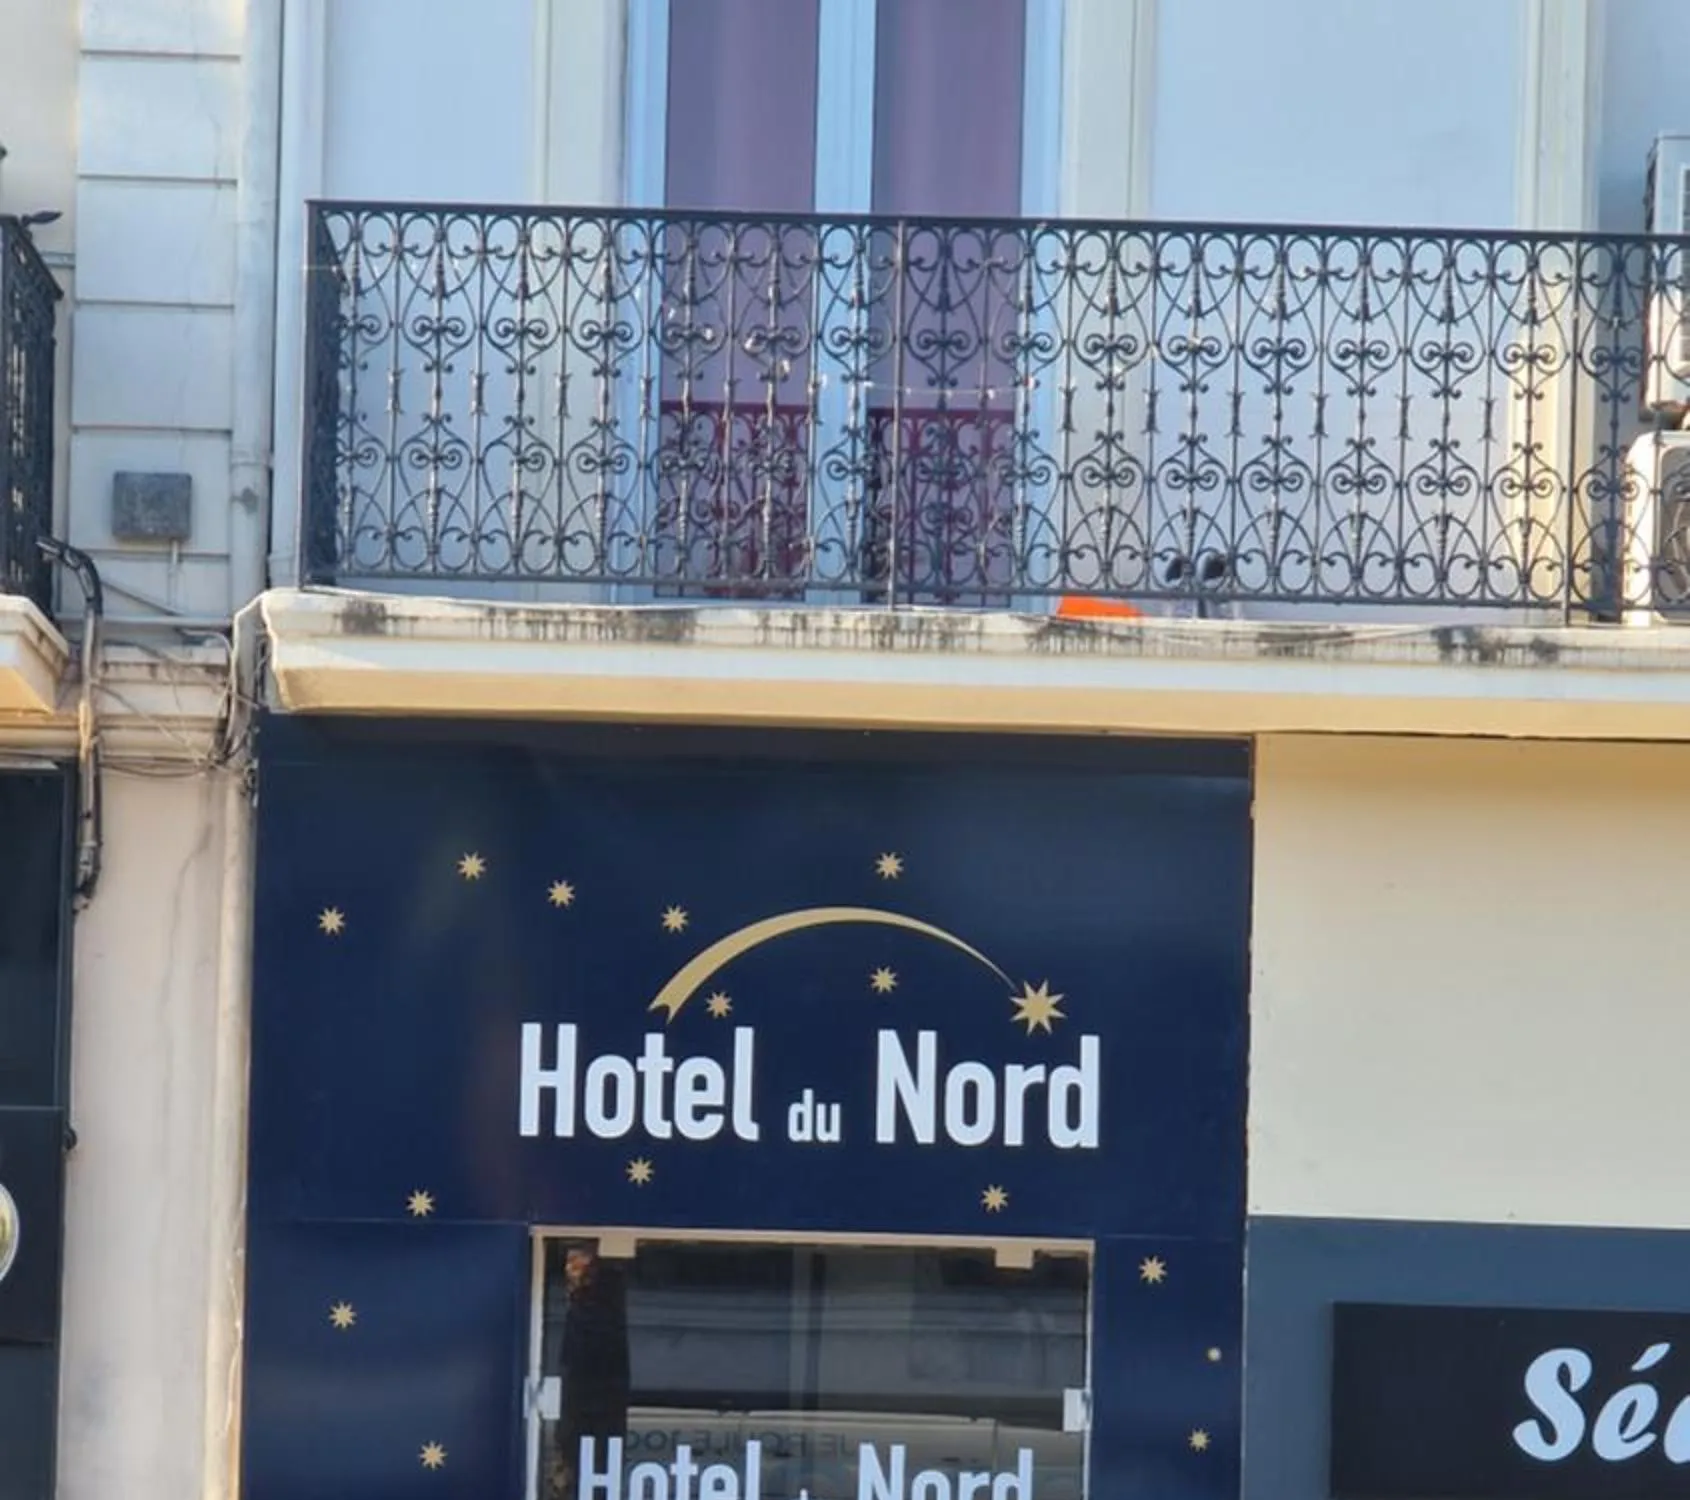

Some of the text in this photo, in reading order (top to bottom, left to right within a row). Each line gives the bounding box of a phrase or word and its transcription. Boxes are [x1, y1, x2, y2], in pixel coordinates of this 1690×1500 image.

[519, 1022, 1101, 1149] Hotel du Nord
